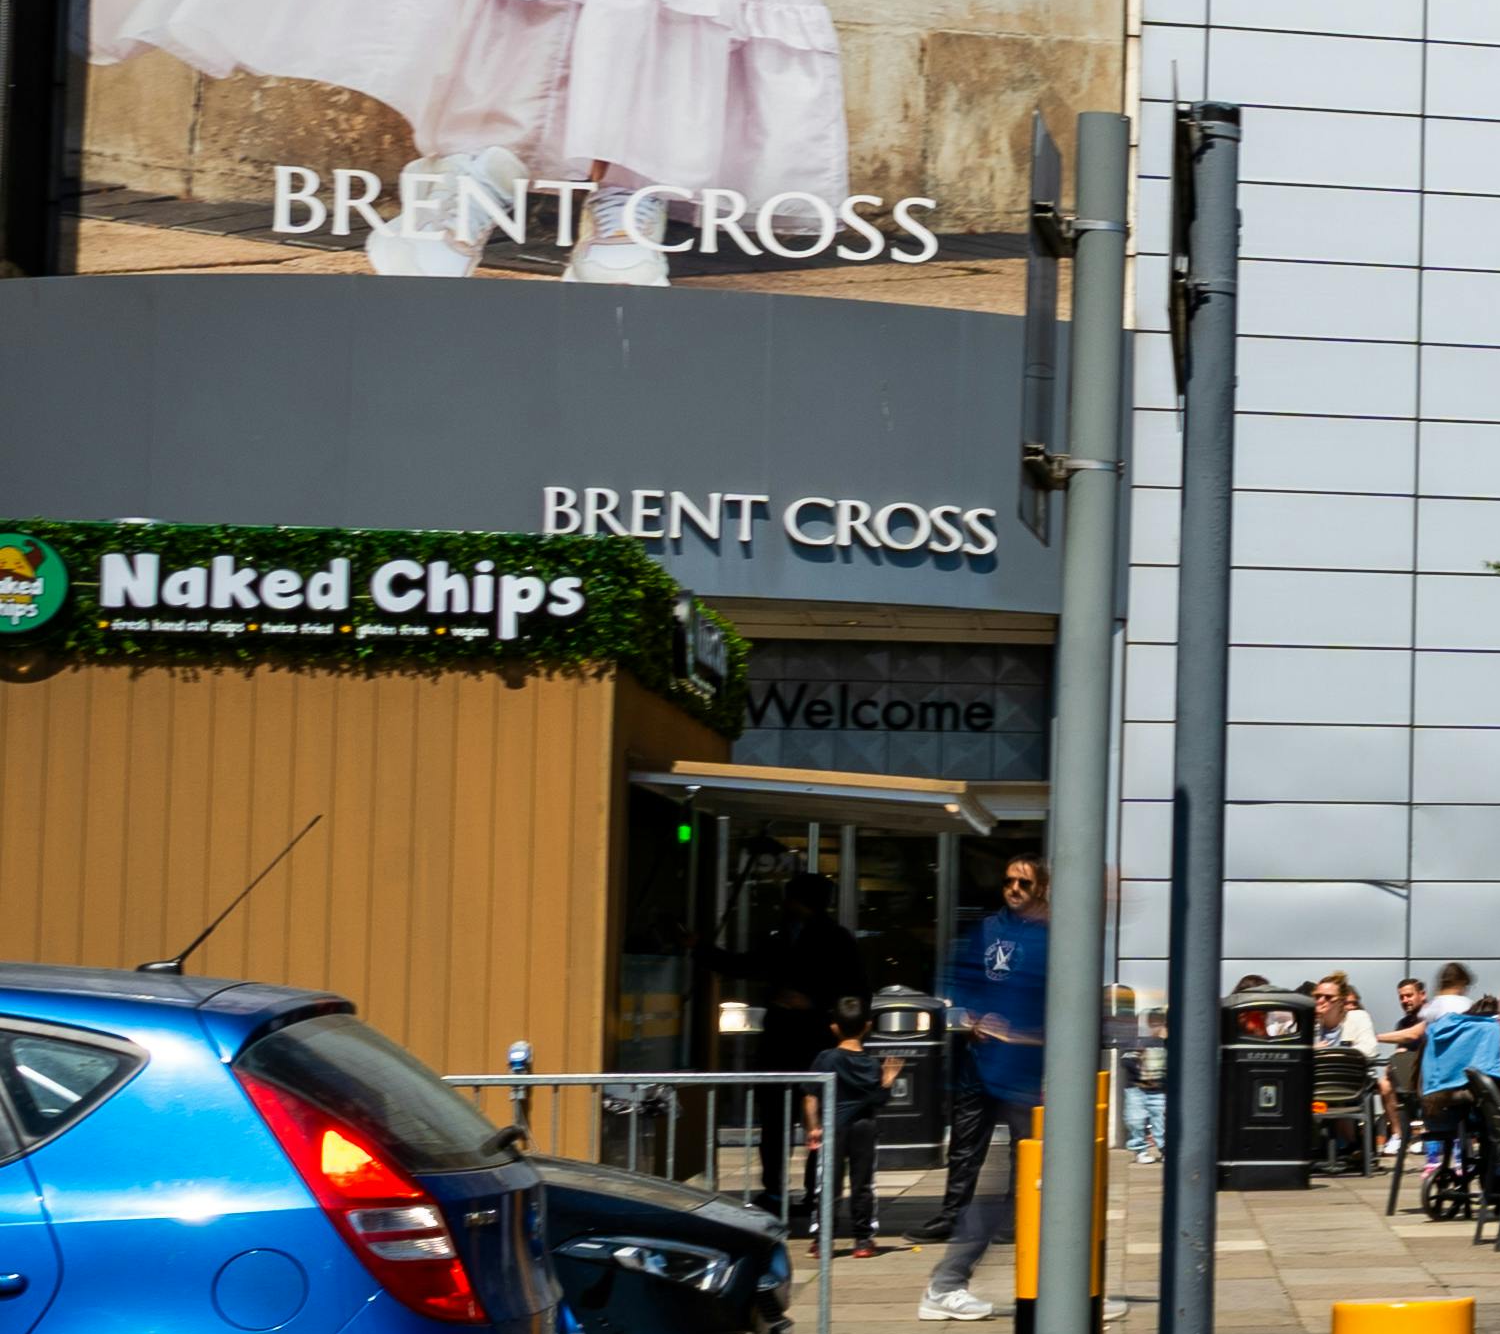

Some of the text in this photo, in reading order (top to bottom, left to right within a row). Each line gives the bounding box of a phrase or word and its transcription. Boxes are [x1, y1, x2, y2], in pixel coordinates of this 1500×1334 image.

[272, 165, 939, 265] BRENT CROSS
[542, 486, 999, 557] BRENT CROSS
[101, 552, 586, 640] Naked Chips
[747, 683, 995, 731] Welcome
